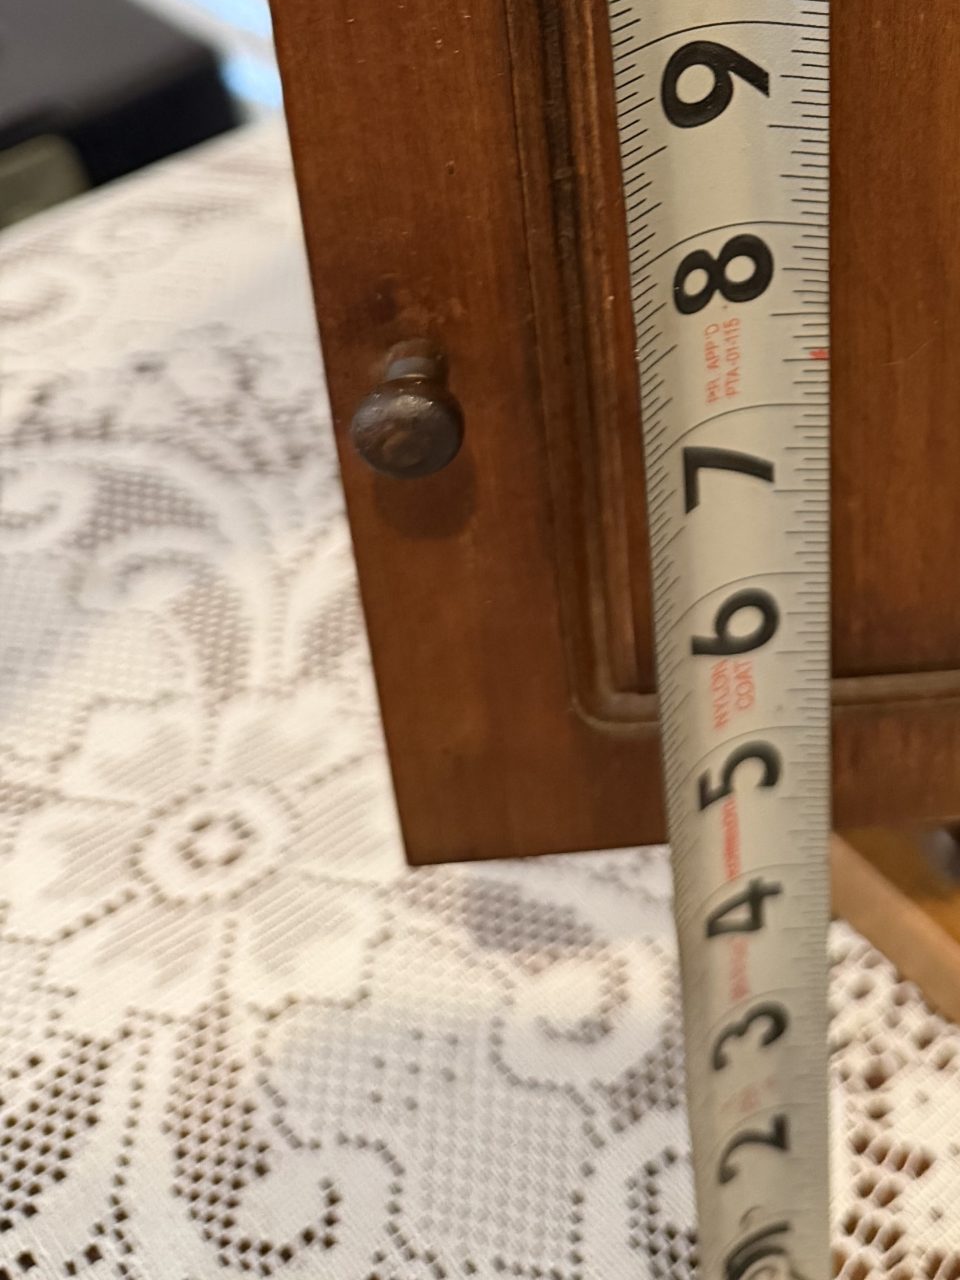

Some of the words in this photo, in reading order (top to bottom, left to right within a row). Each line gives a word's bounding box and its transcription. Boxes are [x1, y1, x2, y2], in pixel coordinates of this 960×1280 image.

[661, 40, 770, 129] 9
[673, 233, 775, 315] 8
[682, 445, 775, 514] 7
[691, 587, 780, 656] 6
[697, 739, 783, 812] 5
[706, 876, 784, 939] 4
[711, 1000, 789, 1071] 3
[717, 1114, 790, 1185] 2
